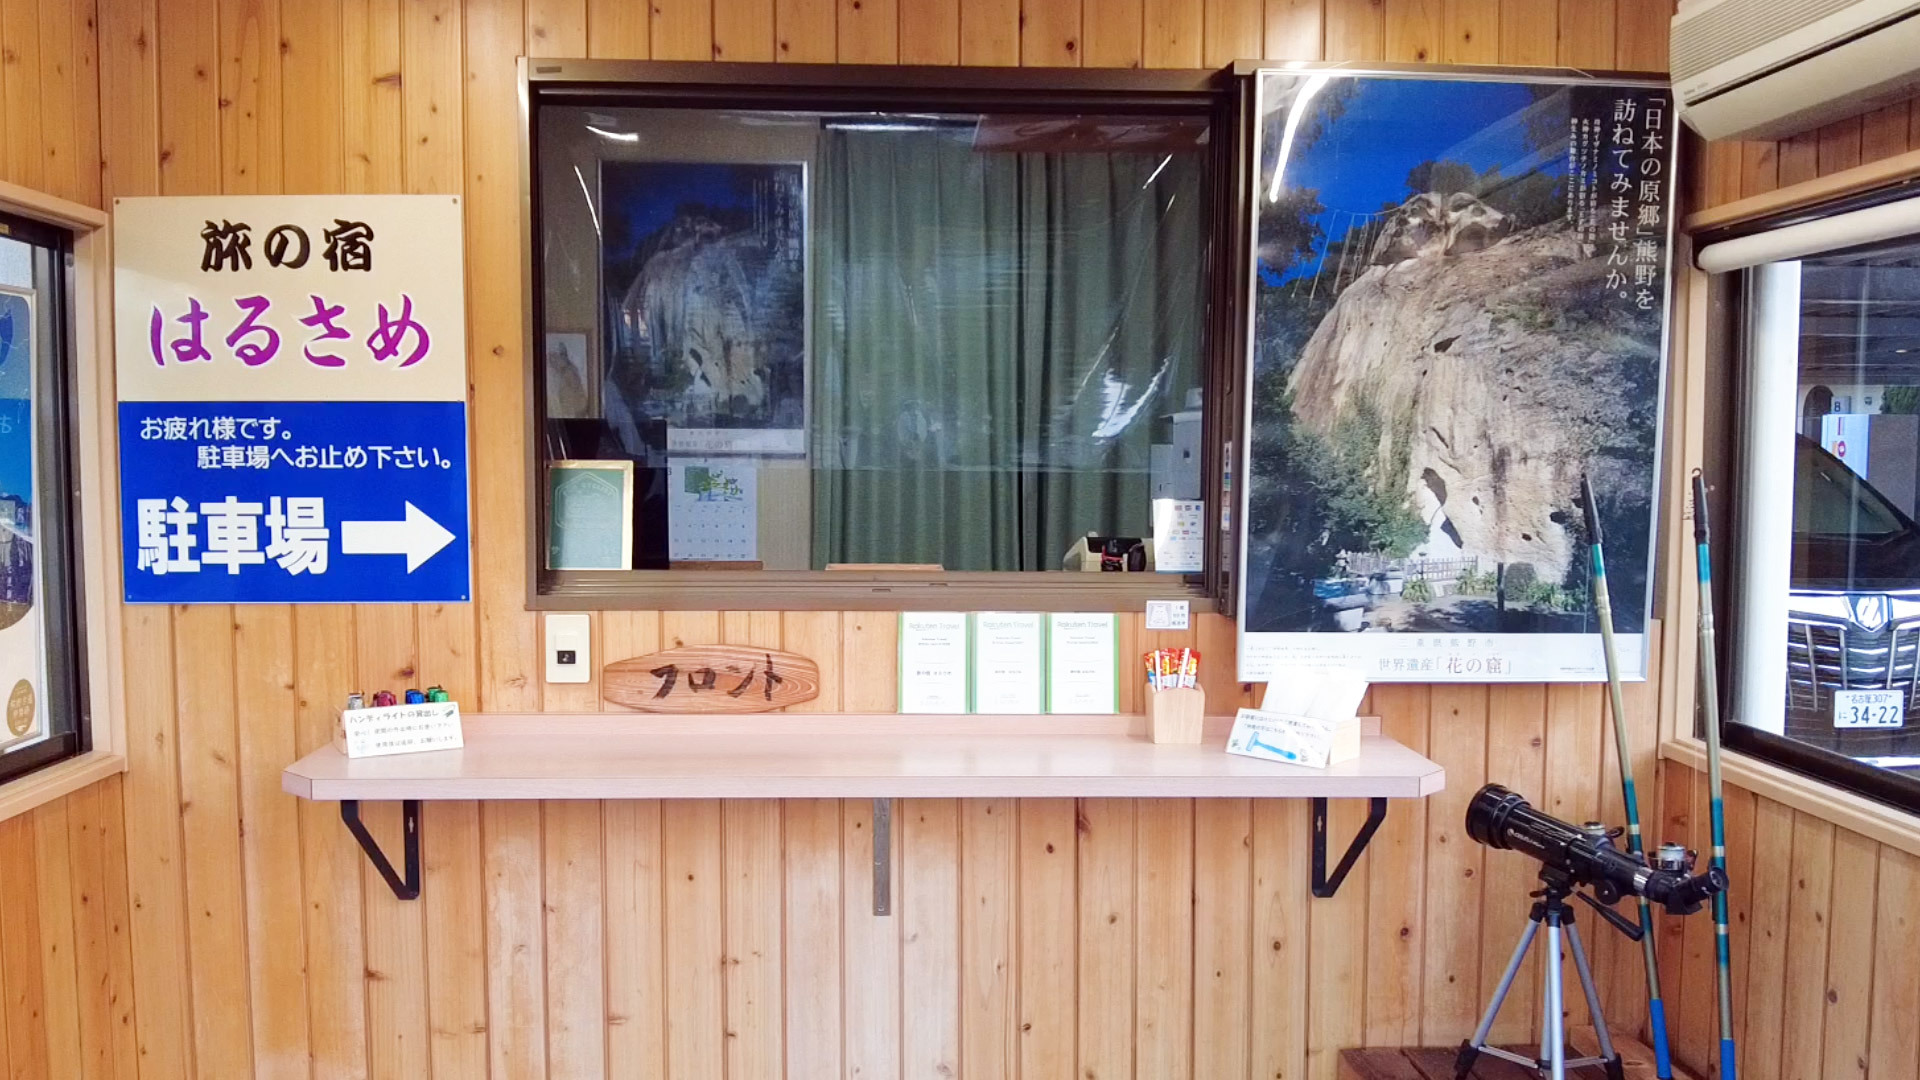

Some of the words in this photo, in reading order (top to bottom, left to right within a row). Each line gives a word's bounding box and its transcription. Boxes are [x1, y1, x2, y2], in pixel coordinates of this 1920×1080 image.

[1605, 98, 1638, 300] 訪ねてみませんか。
[1635, 98, 1667, 311] 「日本の原郷」熊野を
[200, 218, 375, 272] 旅の宿
[149, 293, 431, 369] はるさめ
[139, 416, 293, 441] お疲れ様です。
[197, 444, 454, 469] 駐車場へお止め下さい。
[137, 496, 330, 576] 駐車場
[649, 653, 784, 701] フロント
[1850, 705, 1899, 724] 34-22
